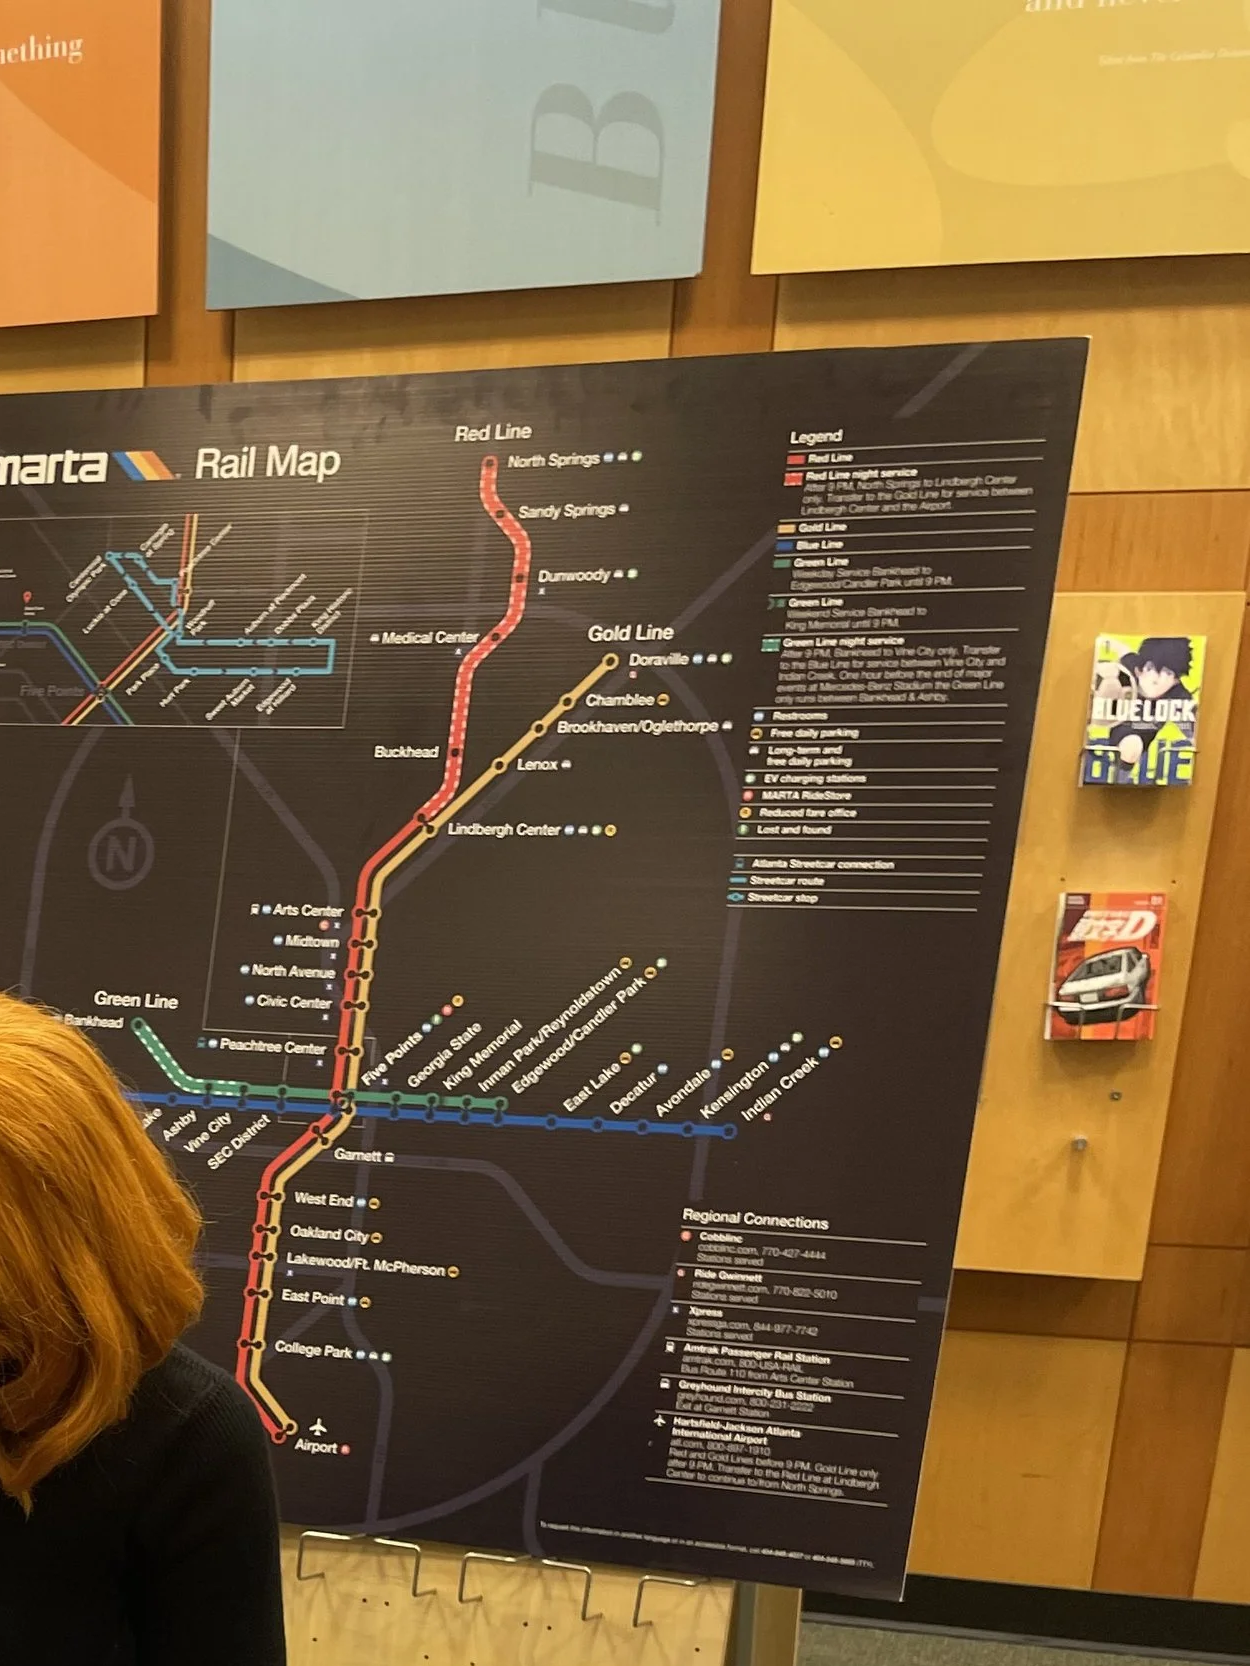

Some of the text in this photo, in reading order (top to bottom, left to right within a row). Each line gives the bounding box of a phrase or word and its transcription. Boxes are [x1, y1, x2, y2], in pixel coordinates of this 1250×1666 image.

[456, 424, 532, 441] Red Line
[790, 430, 843, 446] Legend
[195, 445, 341, 484] Rail Map
[508, 452, 600, 468] North Springs
[808, 453, 853, 463] Red Line
[519, 503, 616, 520] Sandy Springs
[799, 523, 847, 533] Gold Line
[796, 540, 844, 550] Blue Line
[794, 558, 849, 568] Green Line
[538, 569, 611, 583] Dunwoody
[382, 630, 479, 643] Medical Center
[588, 625, 674, 641] Gold Line
[630, 653, 689, 665] Doraville
[586, 694, 654, 706] Chamblee
[773, 711, 828, 721] Restrooms
[557, 720, 719, 734] Brookhaven/Oglethorpe
[770, 728, 859, 740] Free daily parking
[374, 746, 439, 758] Buckhead
[517, 759, 558, 771] Lenox
[448, 824, 561, 838] Lindbergh Center
[757, 825, 832, 834] Lost and found
[790, 860, 835, 869] Streetcar
[838, 860, 894, 870] connection
[750, 876, 824, 886] Streetcar route
[748, 893, 818, 904] Streetcar stop
[273, 904, 343, 918] Arts Center
[285, 935, 339, 947] Midtown
[252, 965, 335, 979] North Avenue
[94, 991, 178, 1009] Green Line
[257, 995, 331, 1009] Civic Center
[65, 1014, 123, 1028] Bankhead
[478, 967, 622, 1093] Inman Park/Reynoldstown
[511, 976, 647, 1095] Edgewood/Candler Park
[220, 1039, 326, 1055] Peachtree Center
[442, 1019, 523, 1090] King Memorial
[361, 1031, 423, 1086] Five Points
[407, 1023, 483, 1088] Georgia State
[563, 1061, 621, 1114] East Lake
[609, 1072, 658, 1116] Decatur
[655, 1068, 712, 1118] Avondale
[700, 1061, 770, 1120] Kensington
[741, 1057, 819, 1122] Indian Creek
[162, 1110, 197, 1141] Ashby
[184, 1112, 232, 1154] Vine City
[207, 1114, 272, 1170] SEC District
[334, 1148, 382, 1162] Garnett
[295, 1192, 354, 1207] West End
[683, 1208, 829, 1230] Regional Connections
[290, 1225, 369, 1245] Oakland City
[287, 1253, 445, 1277] Lakewood/Ft. McPherson
[694, 1269, 762, 1283] Ride Gwinnett
[282, 1289, 344, 1306] East Point
[689, 1306, 723, 1318] Xpress
[275, 1341, 352, 1359] College Park
[684, 1343, 830, 1364] Amtrak Passenger Rail Station
[679, 1380, 831, 1403] Greyhound Intercity Bus Station
[671, 1427, 768, 1446] International Airport
[766, 1425, 801, 1438] Atlanta
[295, 1439, 337, 1455] Airport
